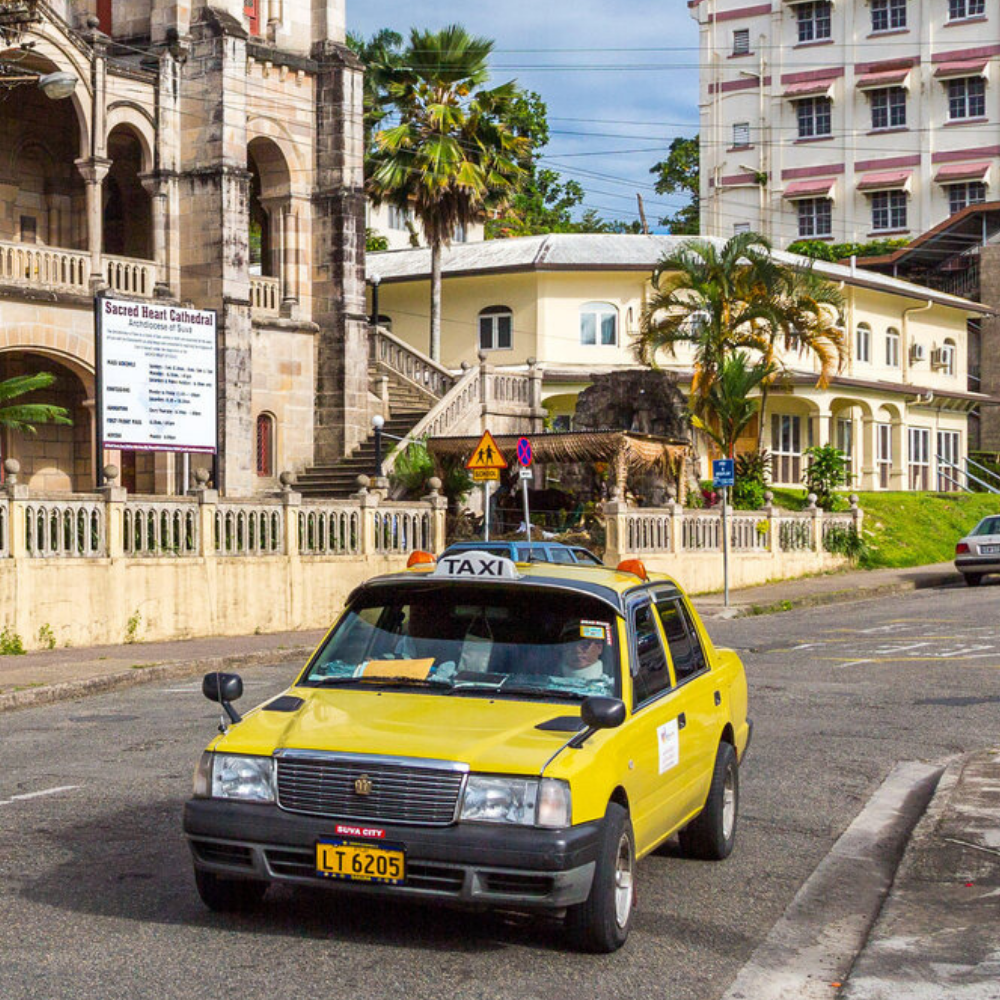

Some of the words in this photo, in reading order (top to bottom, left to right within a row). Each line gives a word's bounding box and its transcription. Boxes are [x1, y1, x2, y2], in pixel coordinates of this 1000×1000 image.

[105, 301, 139, 318] Sacred
[141, 306, 168, 321] Heart
[169, 309, 213, 326] Cathedral
[128, 319, 168, 331] Archdiocese
[177, 324, 192, 334] Suva
[444, 559, 504, 576] TAXI
[337, 826, 361, 835] SUVA
[362, 828, 383, 837] CITY
[323, 849, 346, 871] LT
[352, 853, 400, 877] 6205
